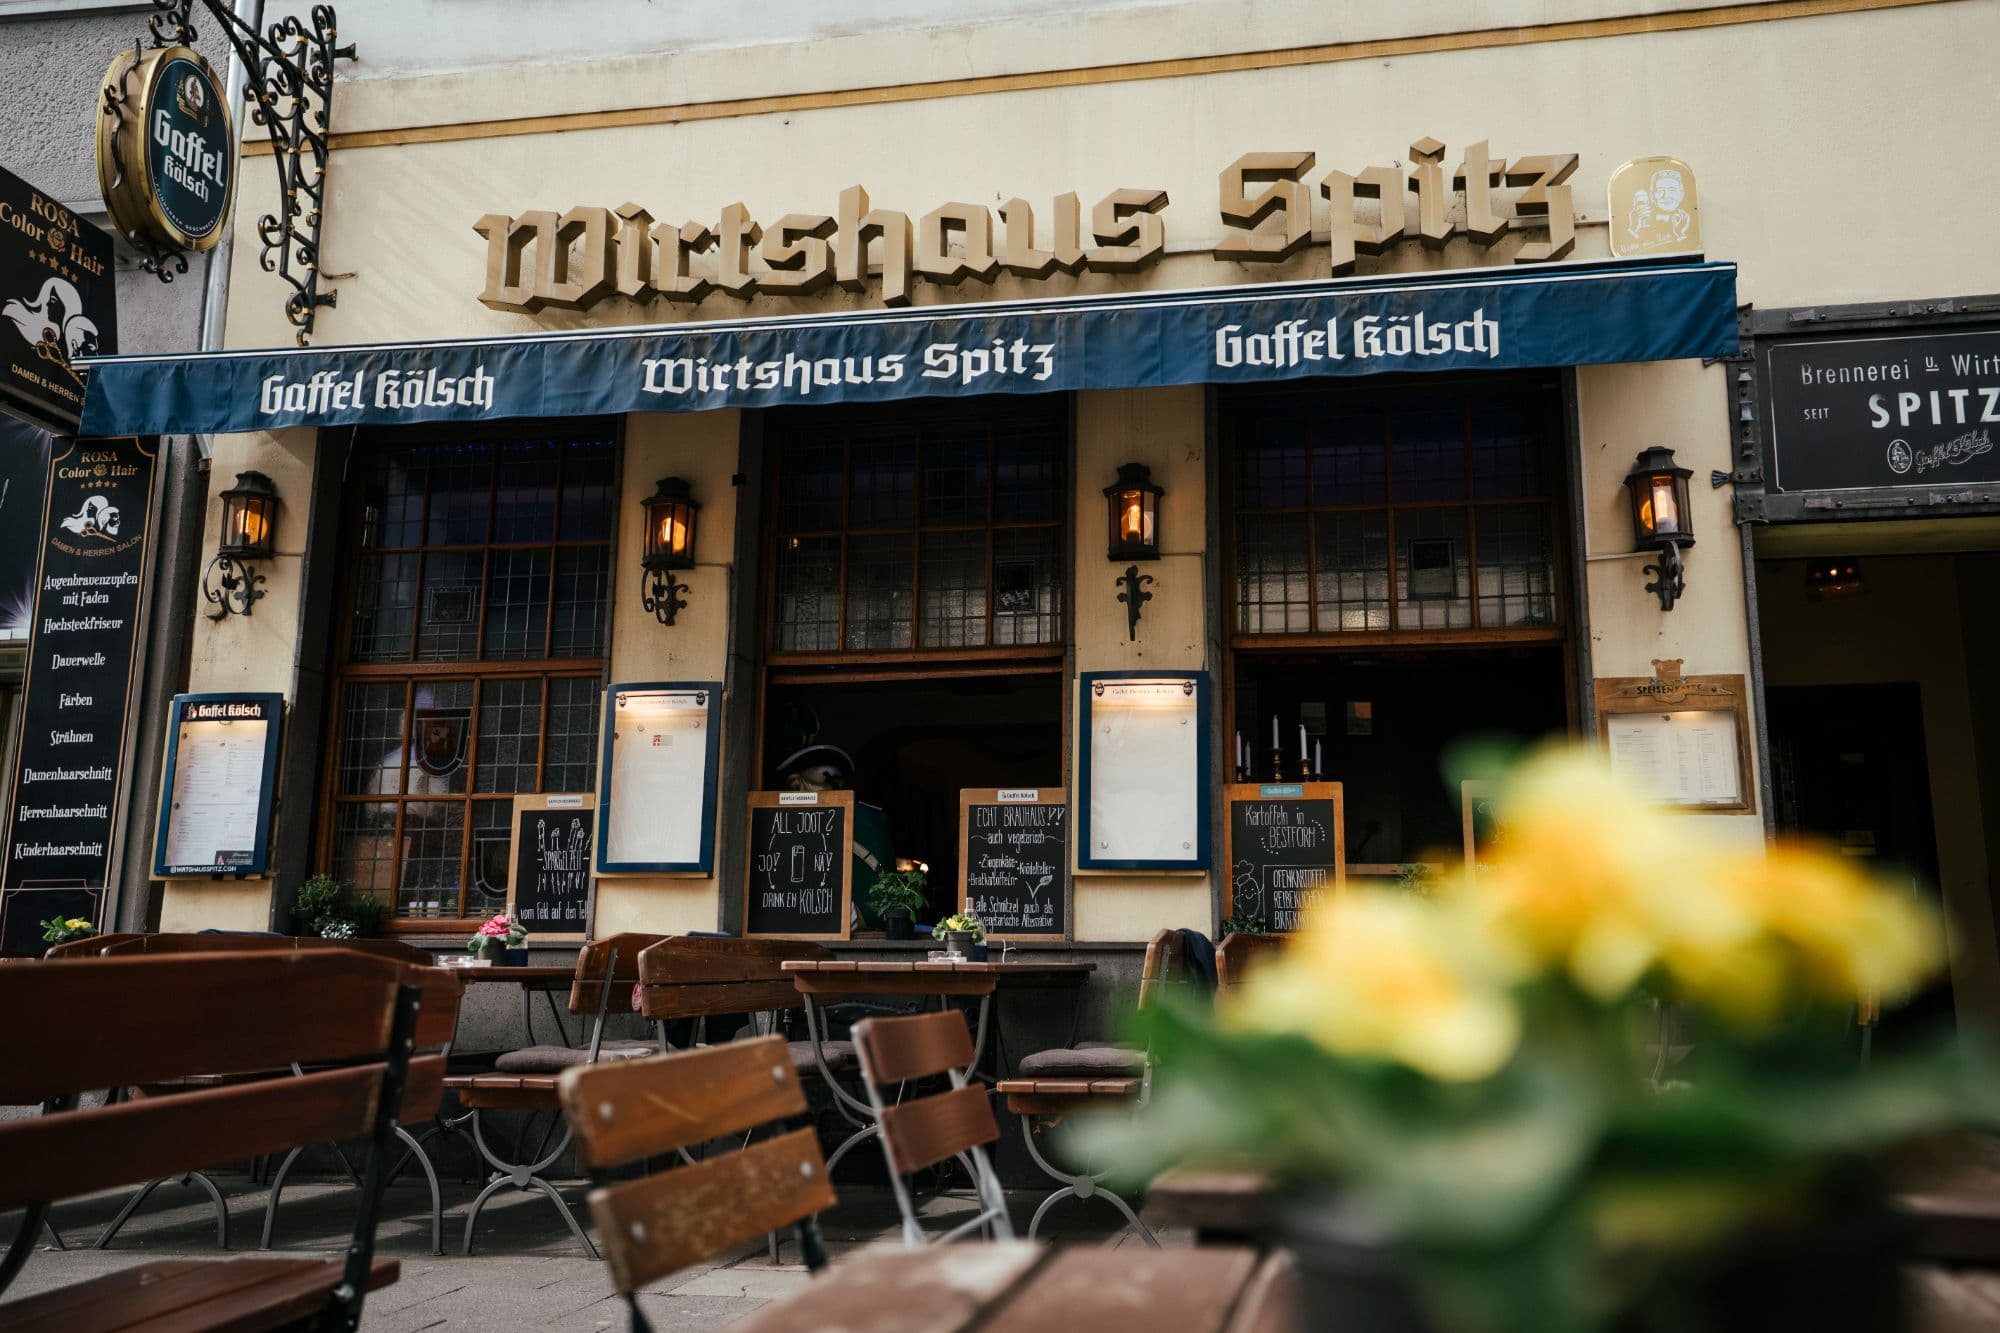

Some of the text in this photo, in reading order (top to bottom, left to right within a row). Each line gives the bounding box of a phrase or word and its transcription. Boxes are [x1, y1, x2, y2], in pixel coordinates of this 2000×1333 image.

[154, 108, 225, 187] Gaffel
[163, 154, 209, 203] Kölsch
[31, 191, 81, 238] ROSA
[472, 136, 1579, 314] Wirtshaus Spitz
[0, 202, 105, 278] Color Hair
[1214, 308, 1500, 367] Gaffel Kölsch
[641, 338, 1056, 396] Wirtshaus Spitz
[1801, 353, 2000, 385] Brennerei u. Wirt
[11, 363, 41, 385] DAMEN
[41, 378, 48, 388] &
[48, 381, 80, 404] HERREN
[261, 366, 495, 416] Gaffel Kölsch
[1804, 408, 1829, 420] SEIT
[1868, 387, 2000, 429] SPITZ
[81, 451, 118, 463] ROSA
[58, 464, 139, 479] Color Hair
[51, 534, 143, 557] DAMEN & HERREN SALON
[63, 591, 109, 607] mit Faden
[43, 617, 123, 634] Hochsteckfriseur
[51, 652, 106, 670] Dauerwelle
[59, 693, 93, 710] Färben
[199, 704, 262, 719] Gaffel Kölsch
[50, 730, 94, 746] Strähnen
[23, 766, 113, 784] Damenhaarschnitt
[19, 803, 108, 822] Herrenhaarschnitt
[771, 811, 792, 834] ALL
[977, 807, 998, 827] ECHT
[1245, 804, 1305, 827] Kartoffeln in
[987, 829, 1045, 853] auch vegetarisch
[1269, 826, 1316, 848] BESTFORM
[15, 842, 103, 860] Kinderhaarschnitt
[1273, 869, 1329, 888] OFENKARTOFFEL
[520, 907, 534, 920] vom
[551, 901, 562, 920] auf
[566, 901, 577, 920] den
[762, 892, 785, 908] DRINK
[799, 888, 833, 914] KÖLSCH
[976, 895, 1054, 914] alle Schnitzel auch als
